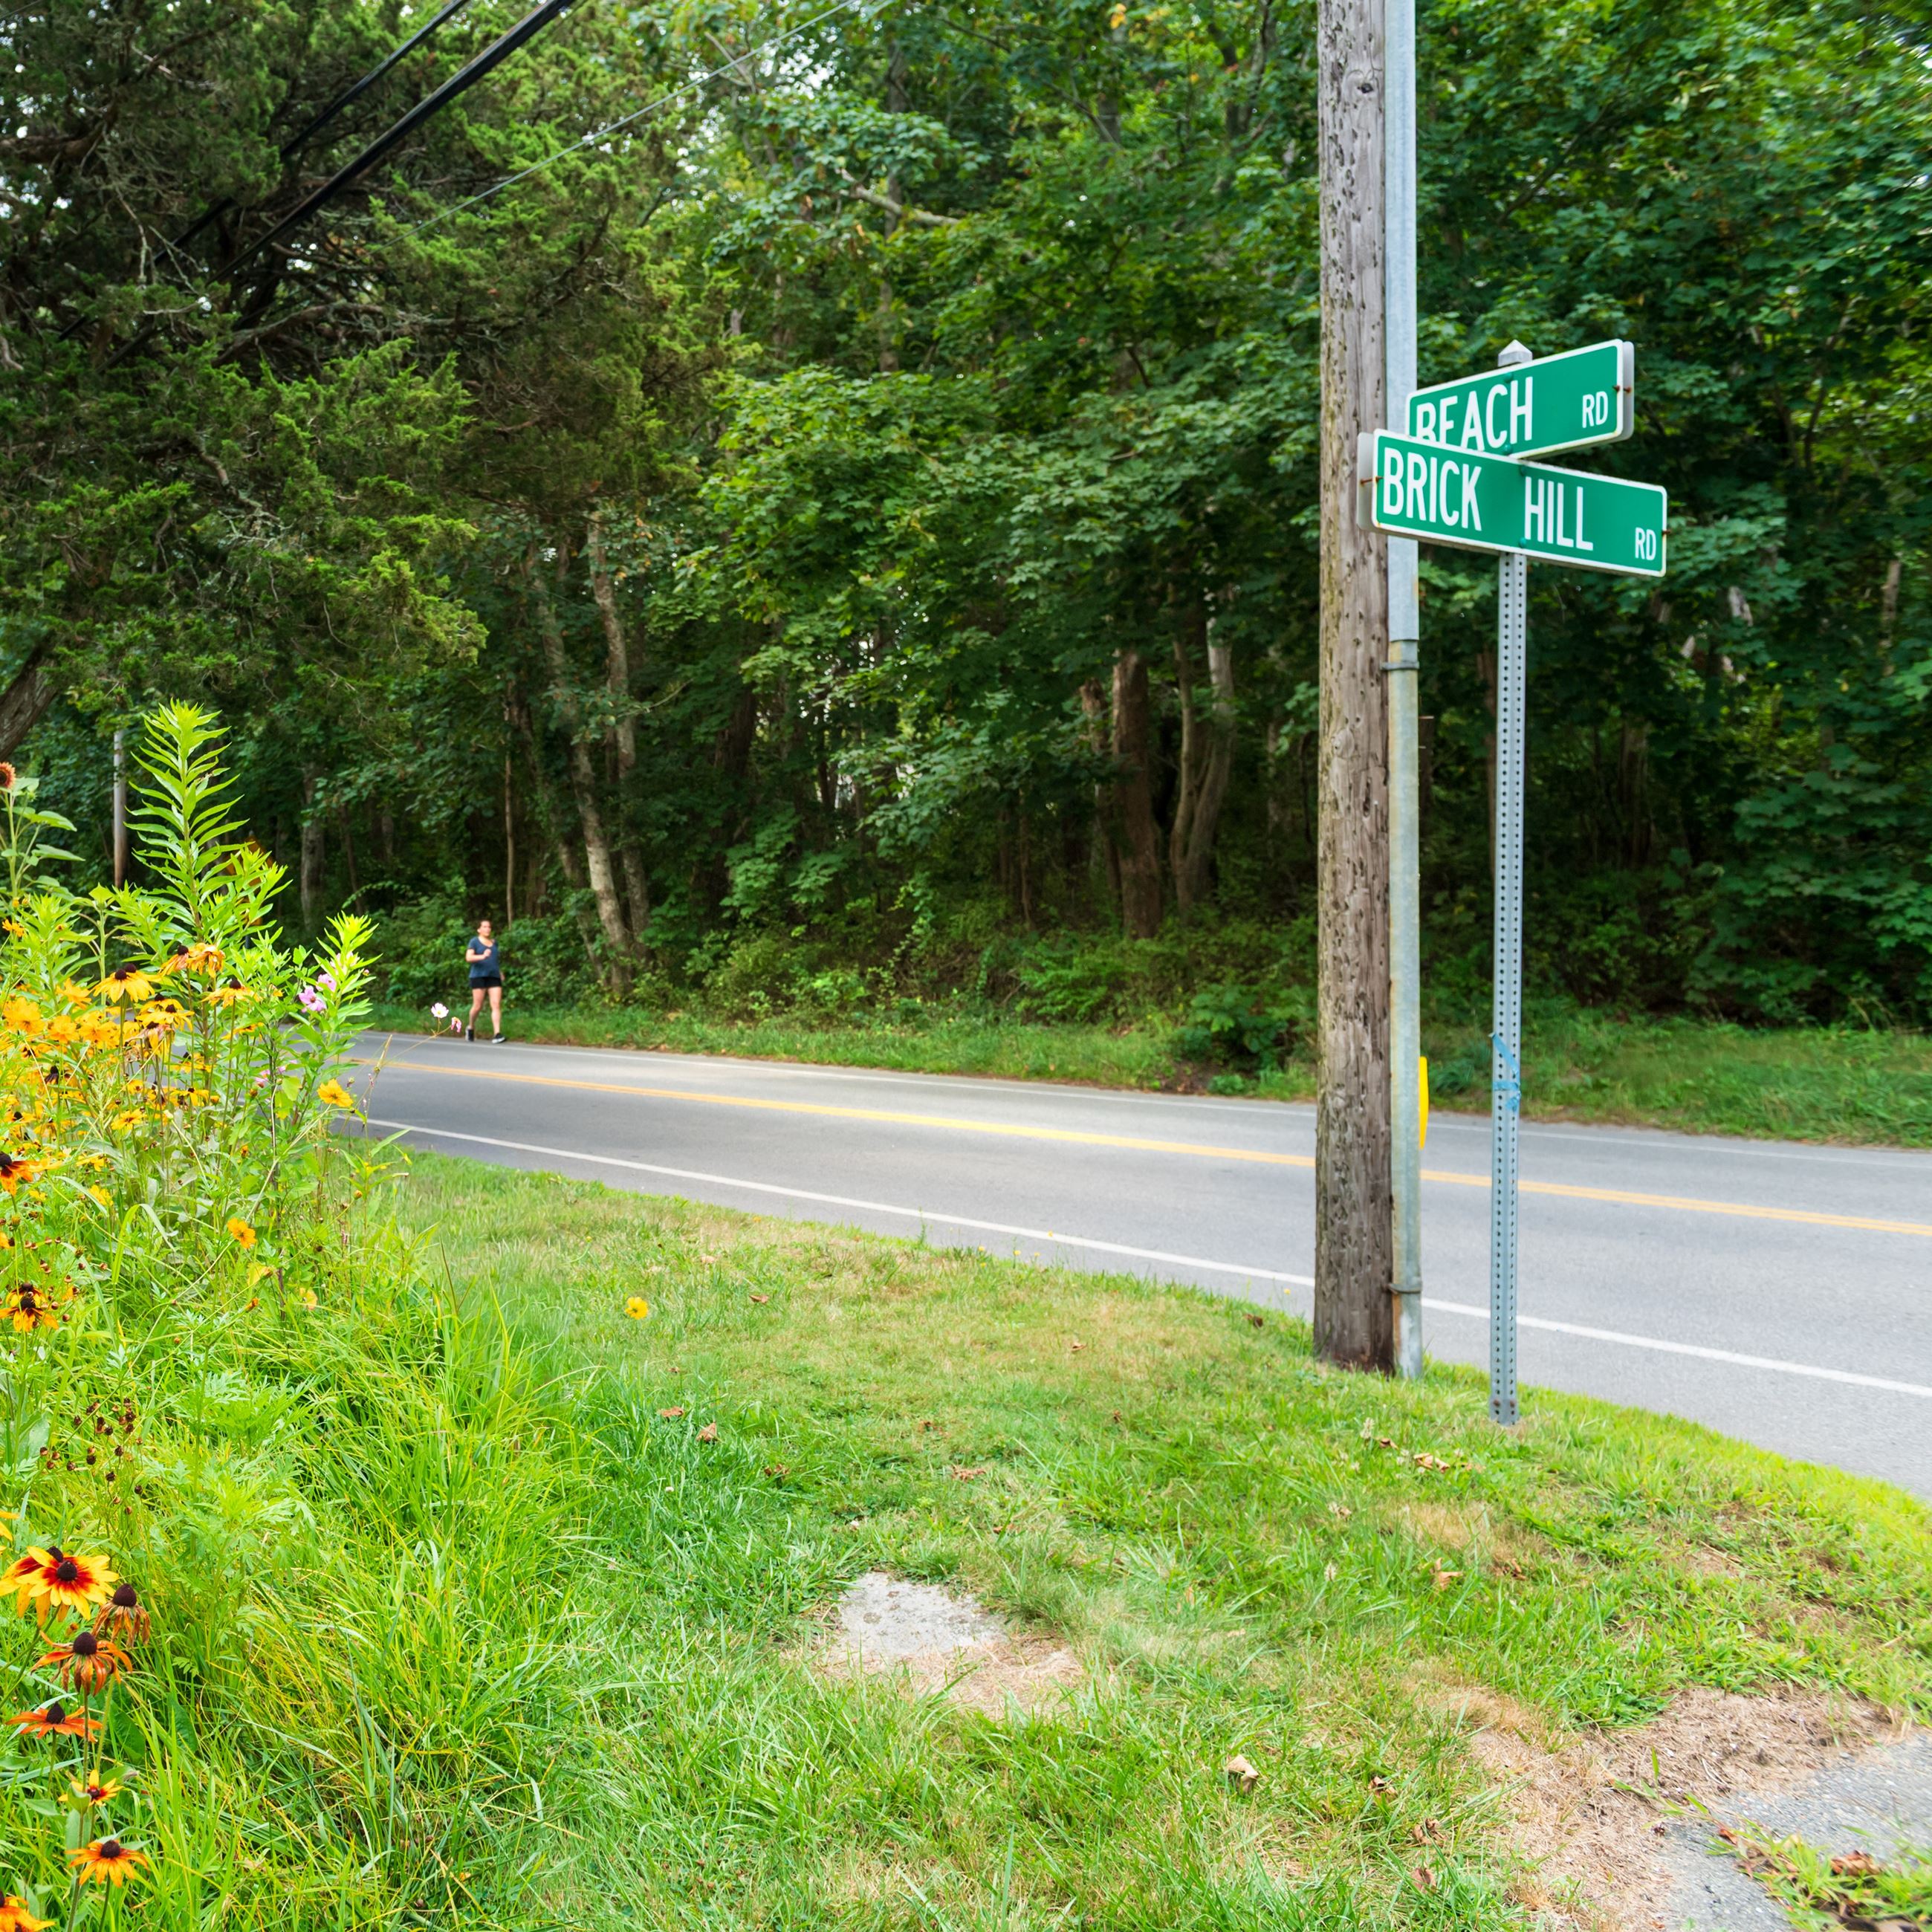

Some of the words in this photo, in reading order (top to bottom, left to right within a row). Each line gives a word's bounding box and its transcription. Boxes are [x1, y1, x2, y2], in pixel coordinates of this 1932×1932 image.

[1416, 376, 1533, 452] BEACH
[1582, 391, 1609, 429] RD
[1383, 447, 1482, 531] BRICK
[1524, 476, 1594, 551] HILL
[1635, 527, 1656, 561] RD
